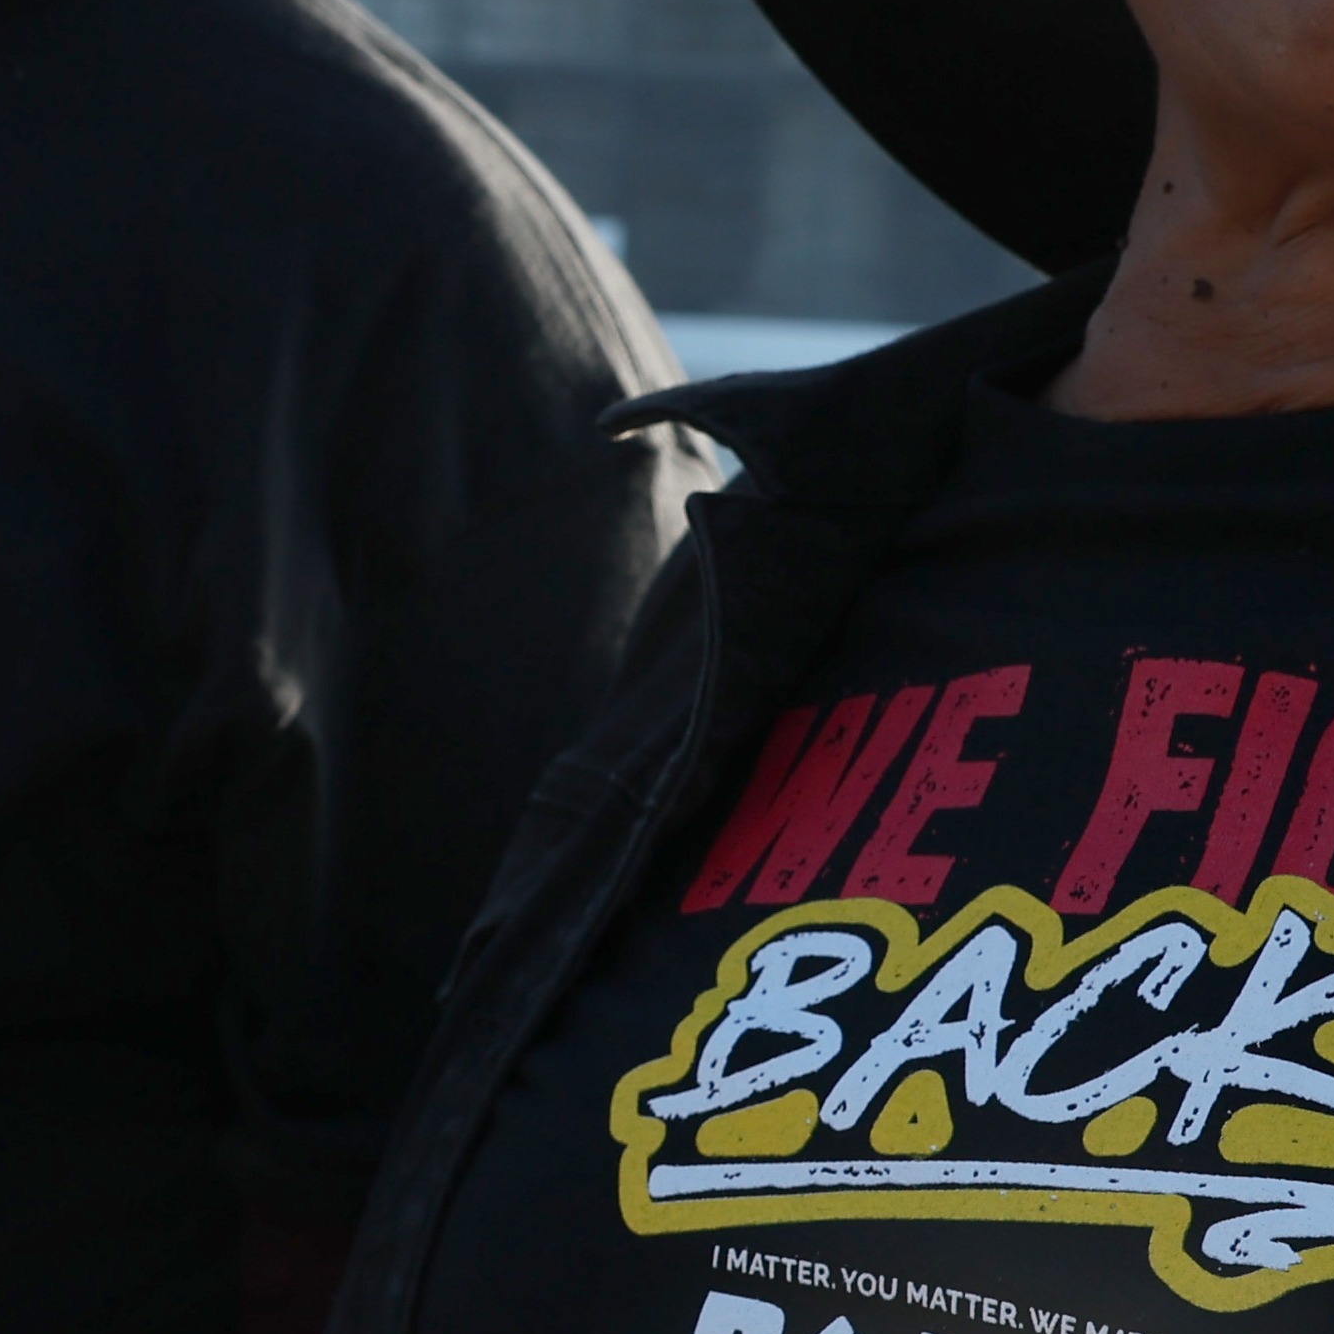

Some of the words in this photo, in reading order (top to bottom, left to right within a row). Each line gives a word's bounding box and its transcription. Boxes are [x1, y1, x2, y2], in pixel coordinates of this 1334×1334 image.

[680, 663, 1032, 915] WE
[711, 1244, 720, 1269] I
[726, 1247, 836, 1290] MATTER.
[840, 1266, 898, 1301] YOU
[906, 1281, 1024, 1330] MATTER.
